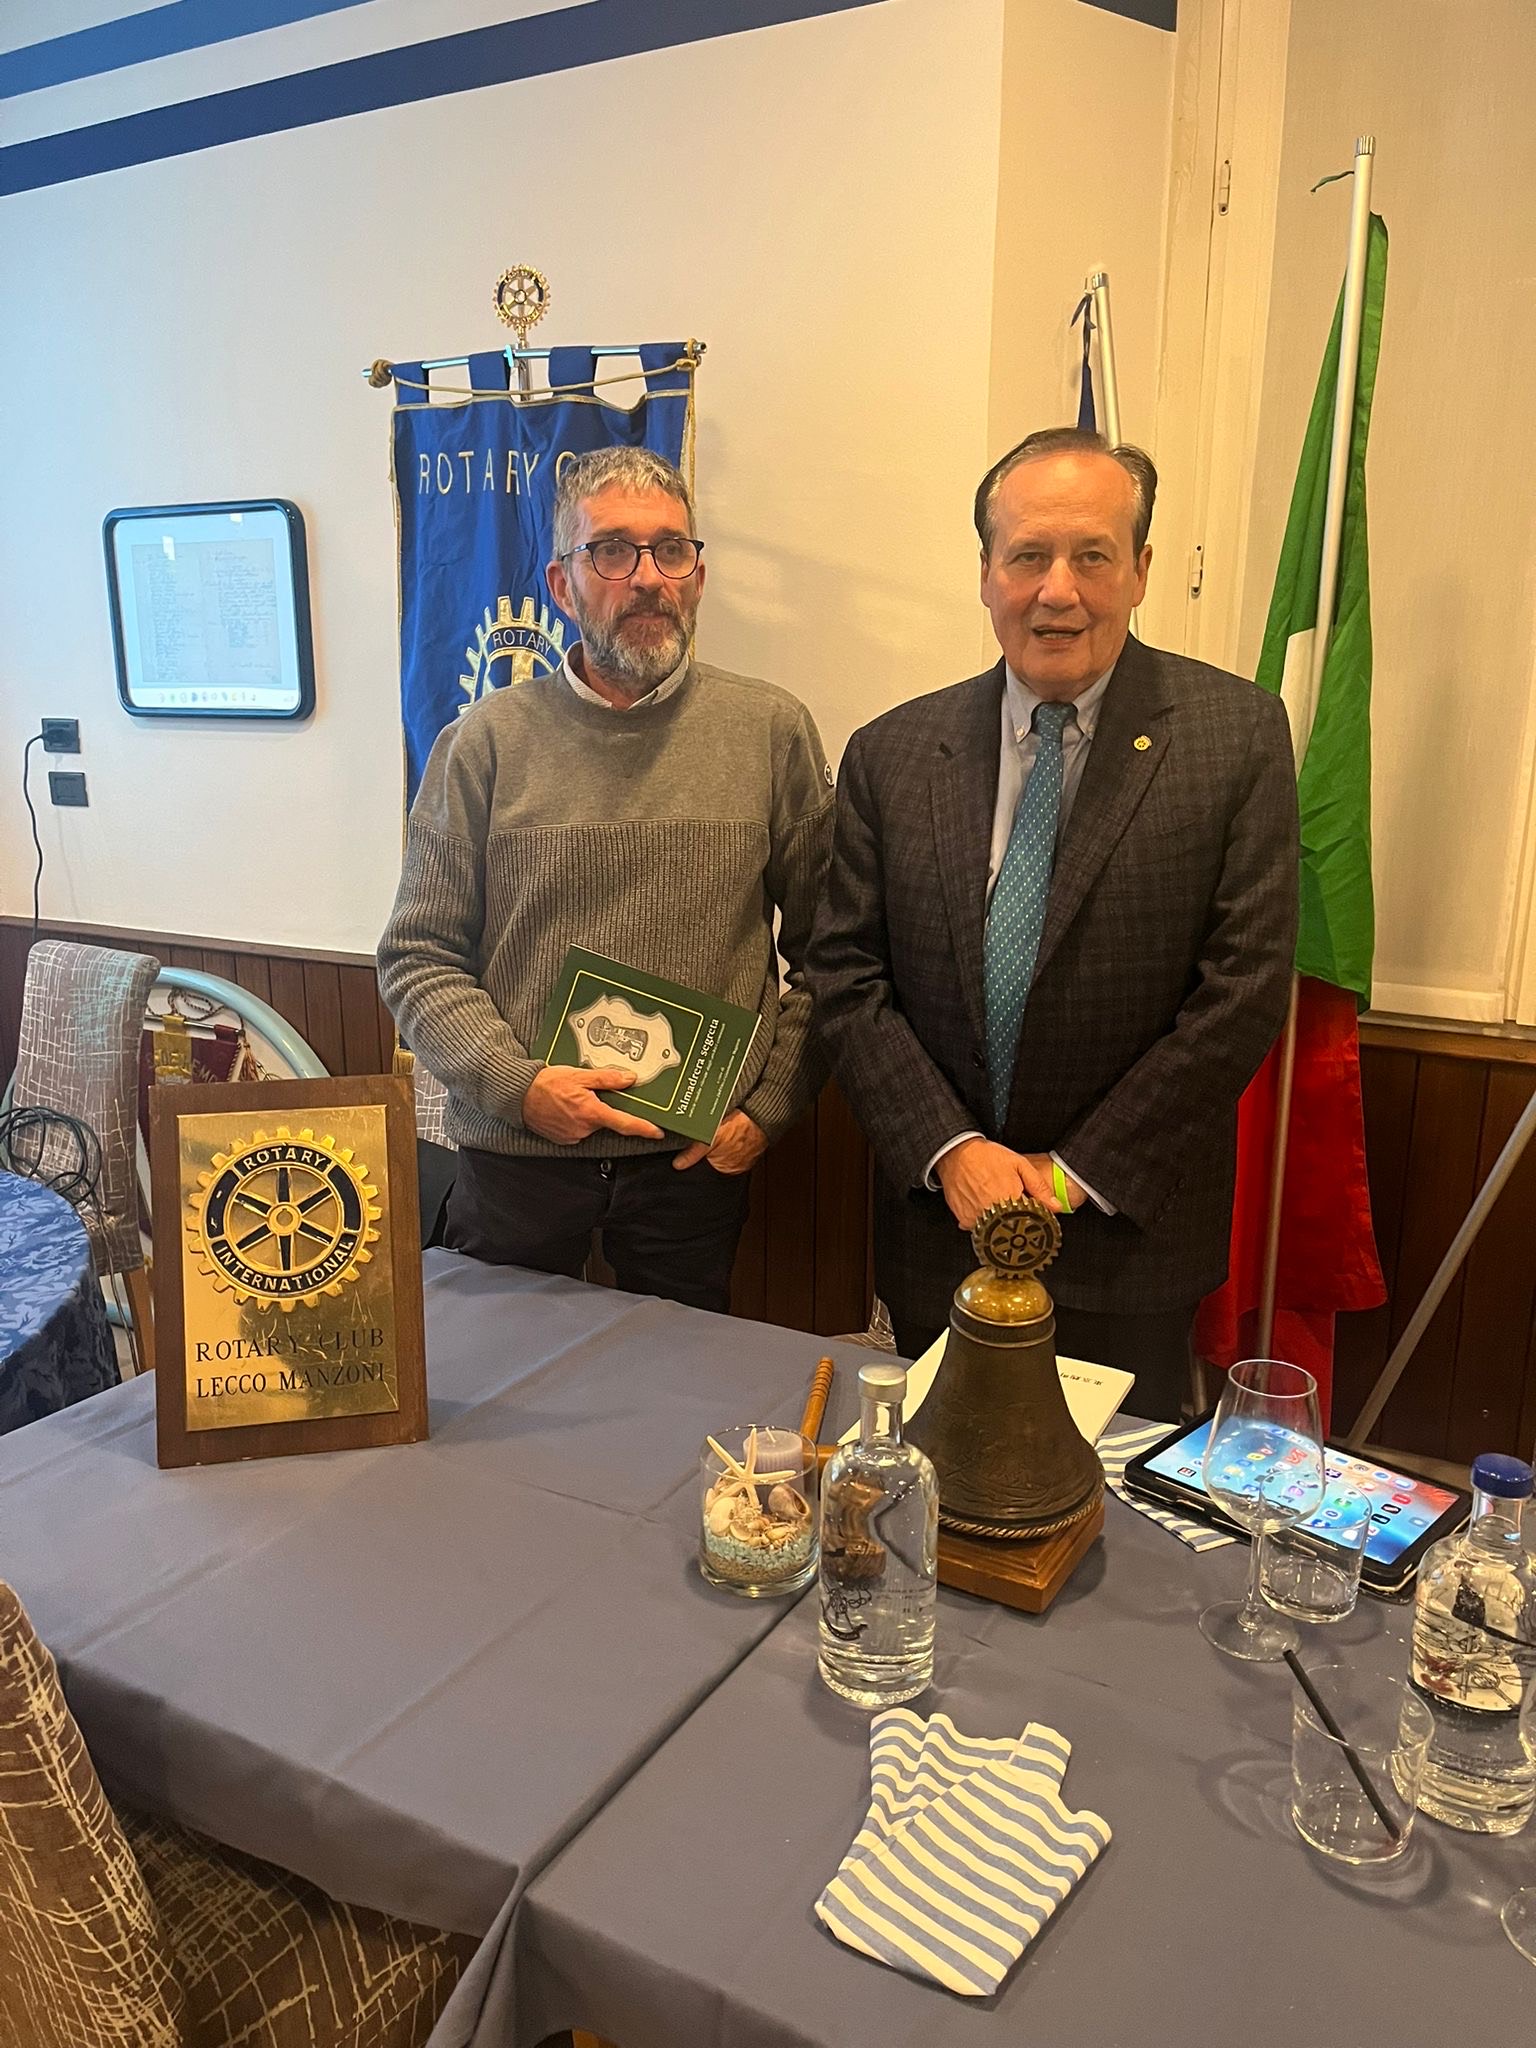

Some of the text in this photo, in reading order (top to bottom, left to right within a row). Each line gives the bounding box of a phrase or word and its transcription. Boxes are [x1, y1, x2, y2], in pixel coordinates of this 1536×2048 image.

[419, 448, 540, 497] ROTARY
[492, 629, 552, 657] ROTARY
[675, 1058, 705, 1116] Valmadrera
[700, 1018, 720, 1057] segreta
[243, 1146, 328, 1172] ROTARY
[214, 1240, 354, 1292] INTERNATIONAL
[196, 1328, 384, 1363] ROTARY CLUB
[197, 1363, 384, 1399] LECCO MANZONI
